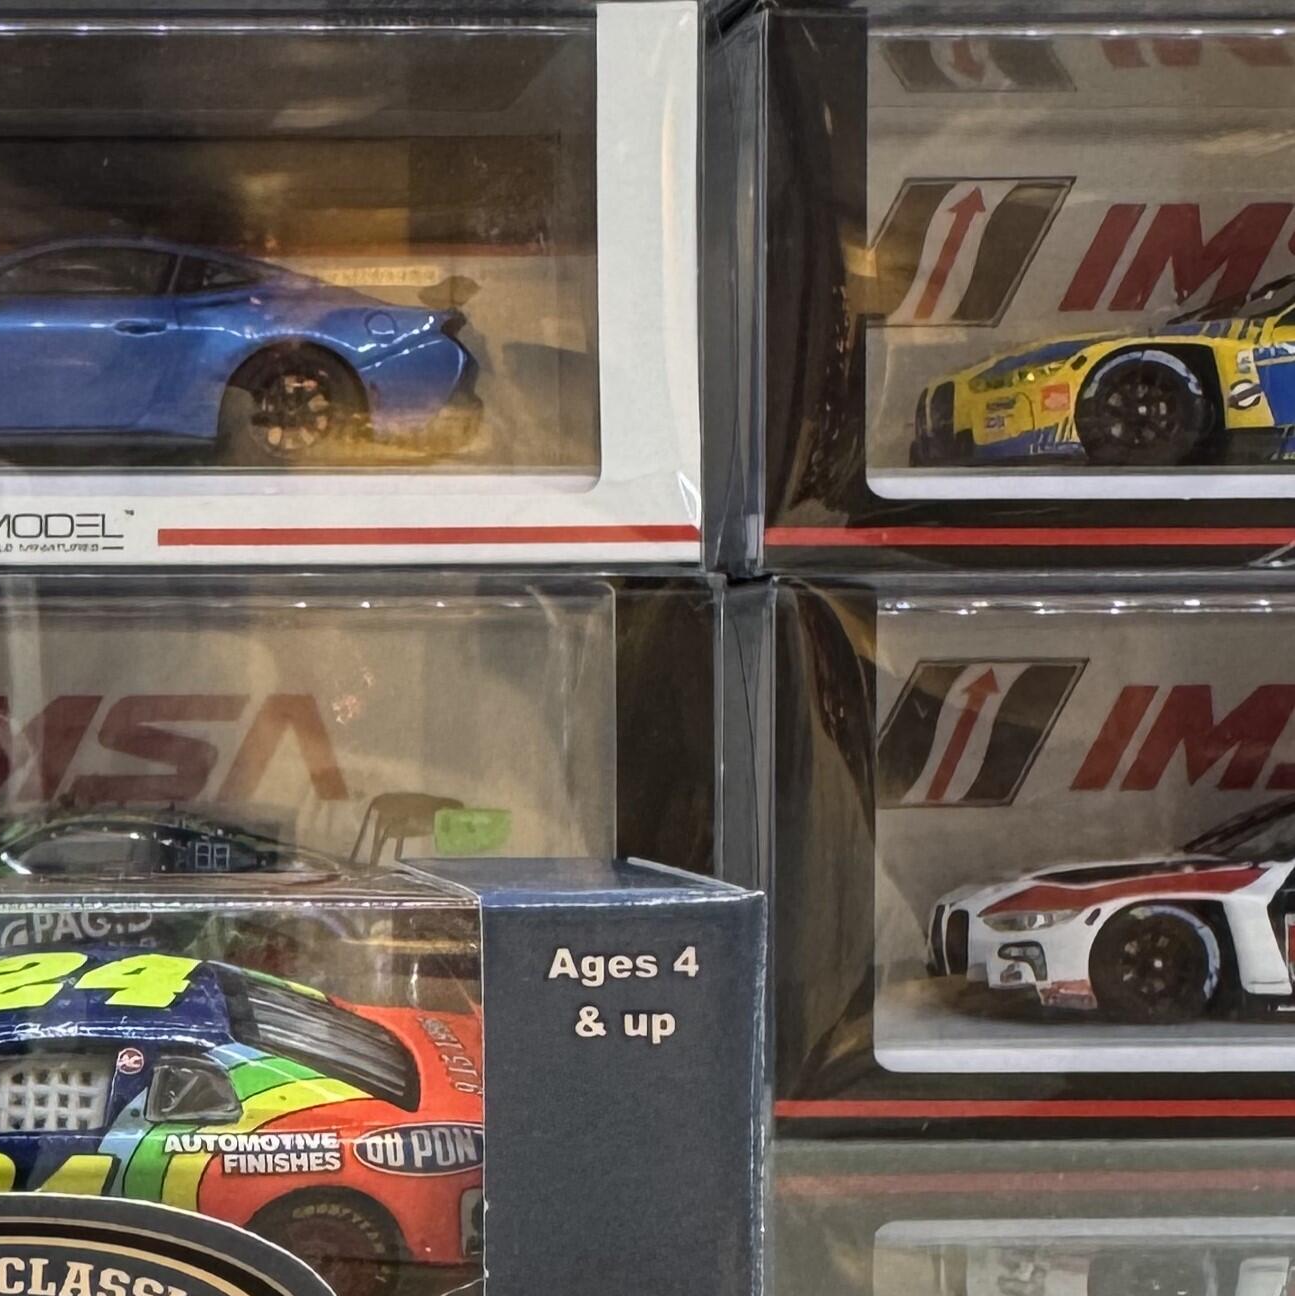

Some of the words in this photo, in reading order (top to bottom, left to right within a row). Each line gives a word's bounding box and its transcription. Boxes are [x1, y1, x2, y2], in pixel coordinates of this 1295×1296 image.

[1057, 203, 1295, 311] IM
[1069, 684, 1295, 791] IM
[548, 948, 658, 987] Ages
[673, 945, 699, 977] 4
[575, 1005, 607, 1037] &
[624, 1012, 676, 1044] up
[164, 1133, 341, 1154] AUTOMOTIVE
[224, 1152, 341, 1174] FINISHES
